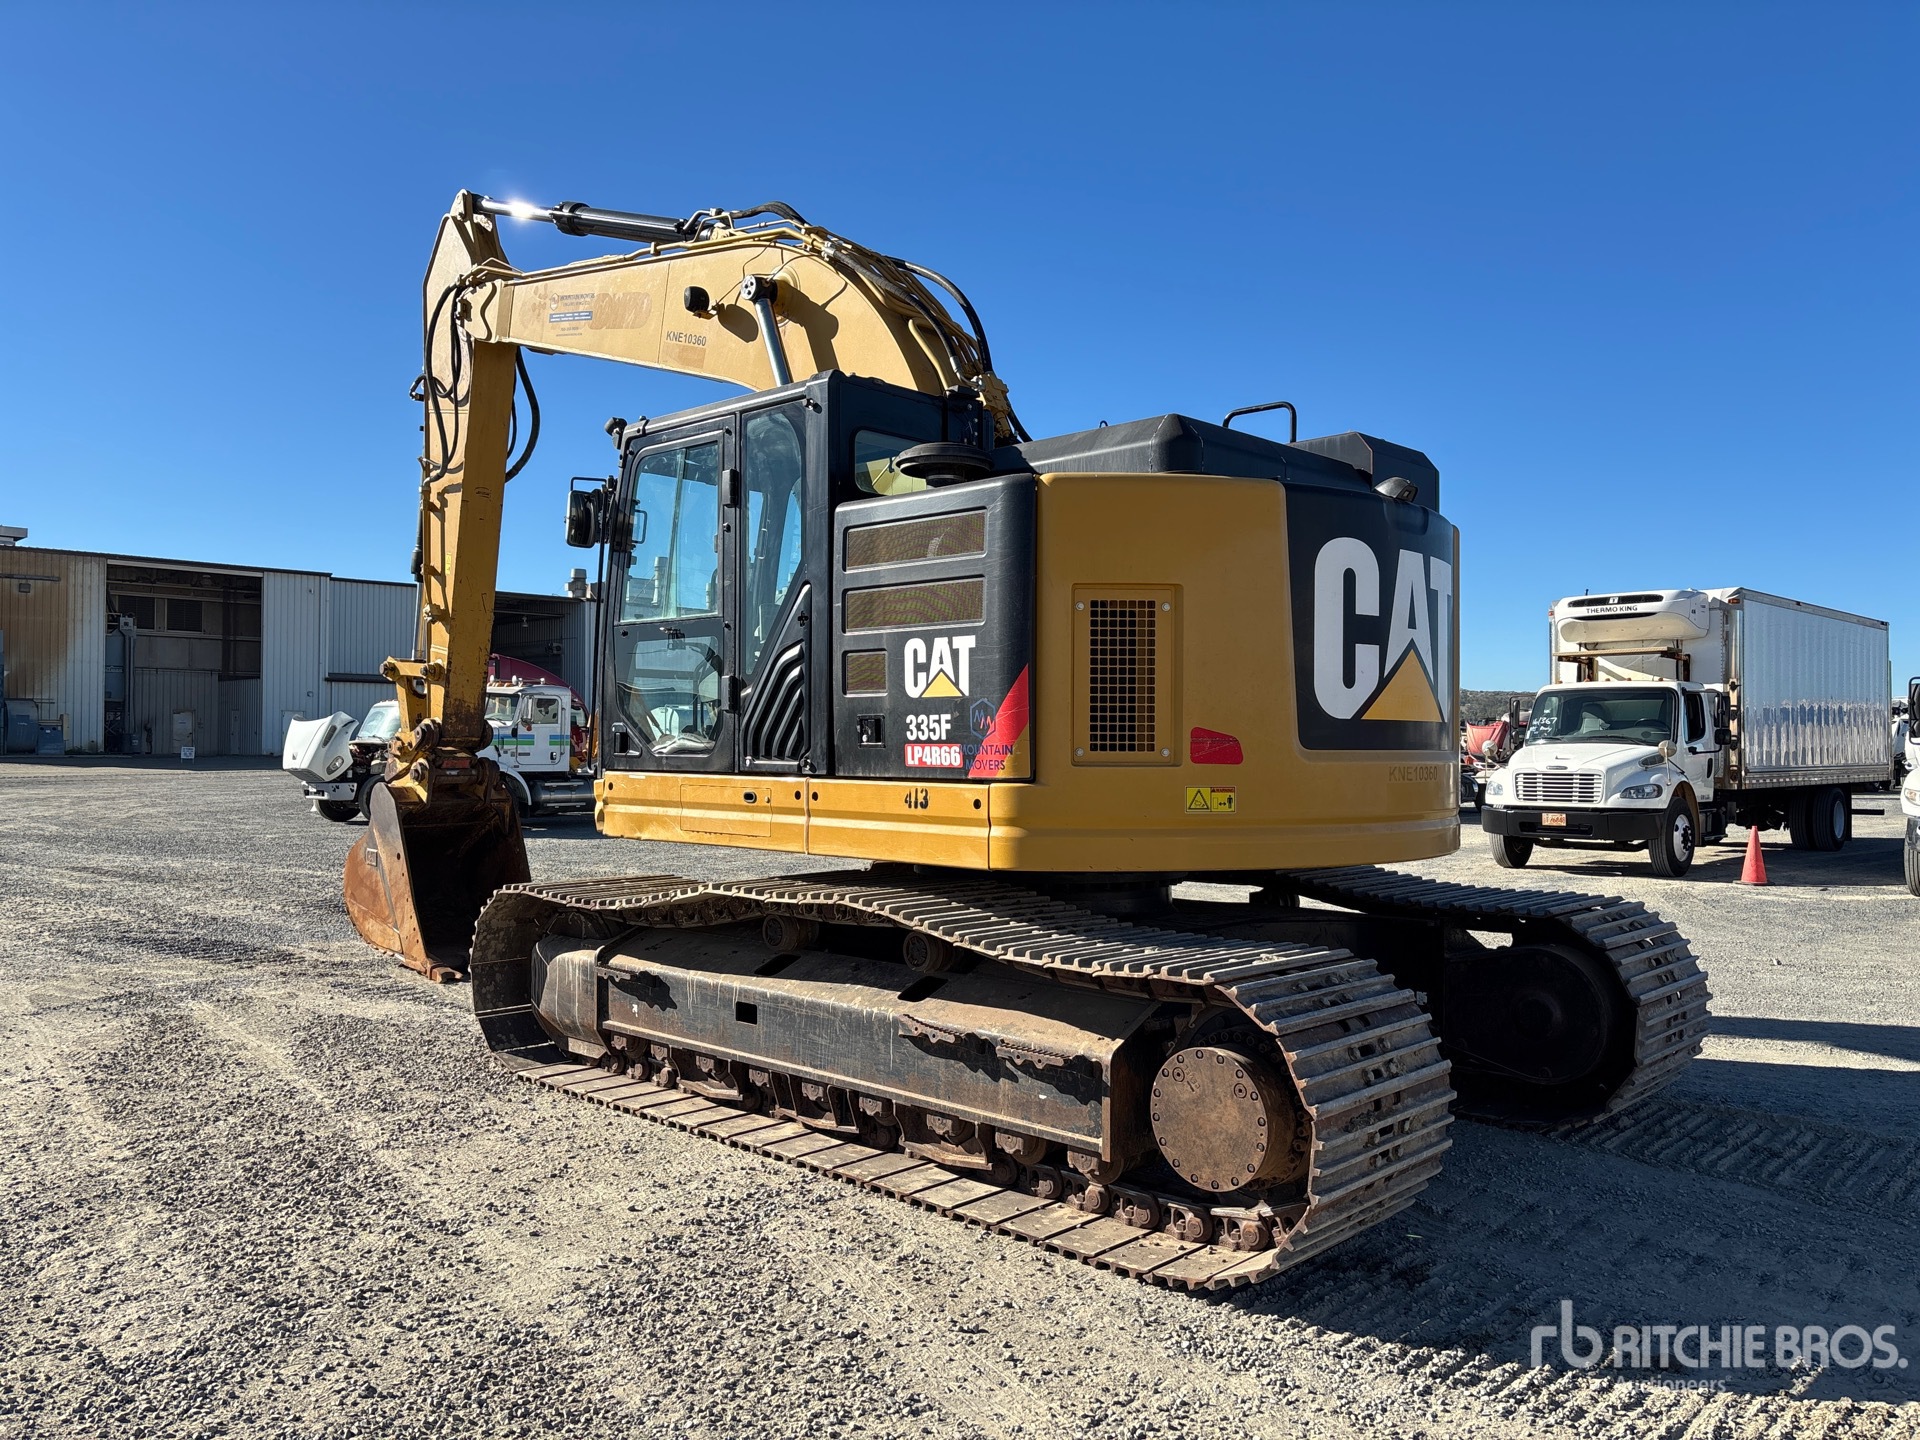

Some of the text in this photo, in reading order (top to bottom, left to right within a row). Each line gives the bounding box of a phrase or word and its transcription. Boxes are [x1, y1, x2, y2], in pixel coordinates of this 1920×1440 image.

[666, 331, 707, 347] KNE10360
[1586, 606, 1618, 614] THERMO
[1314, 537, 1452, 723] CAT
[903, 635, 976, 699] CAT
[906, 713, 952, 741] 335F
[907, 745, 961, 767] LP4R66
[960, 744, 1013, 756] MOUNTAIN
[965, 760, 1006, 771] MOVERS
[1388, 766, 1438, 781] KNE10360
[904, 788, 929, 809] 413
